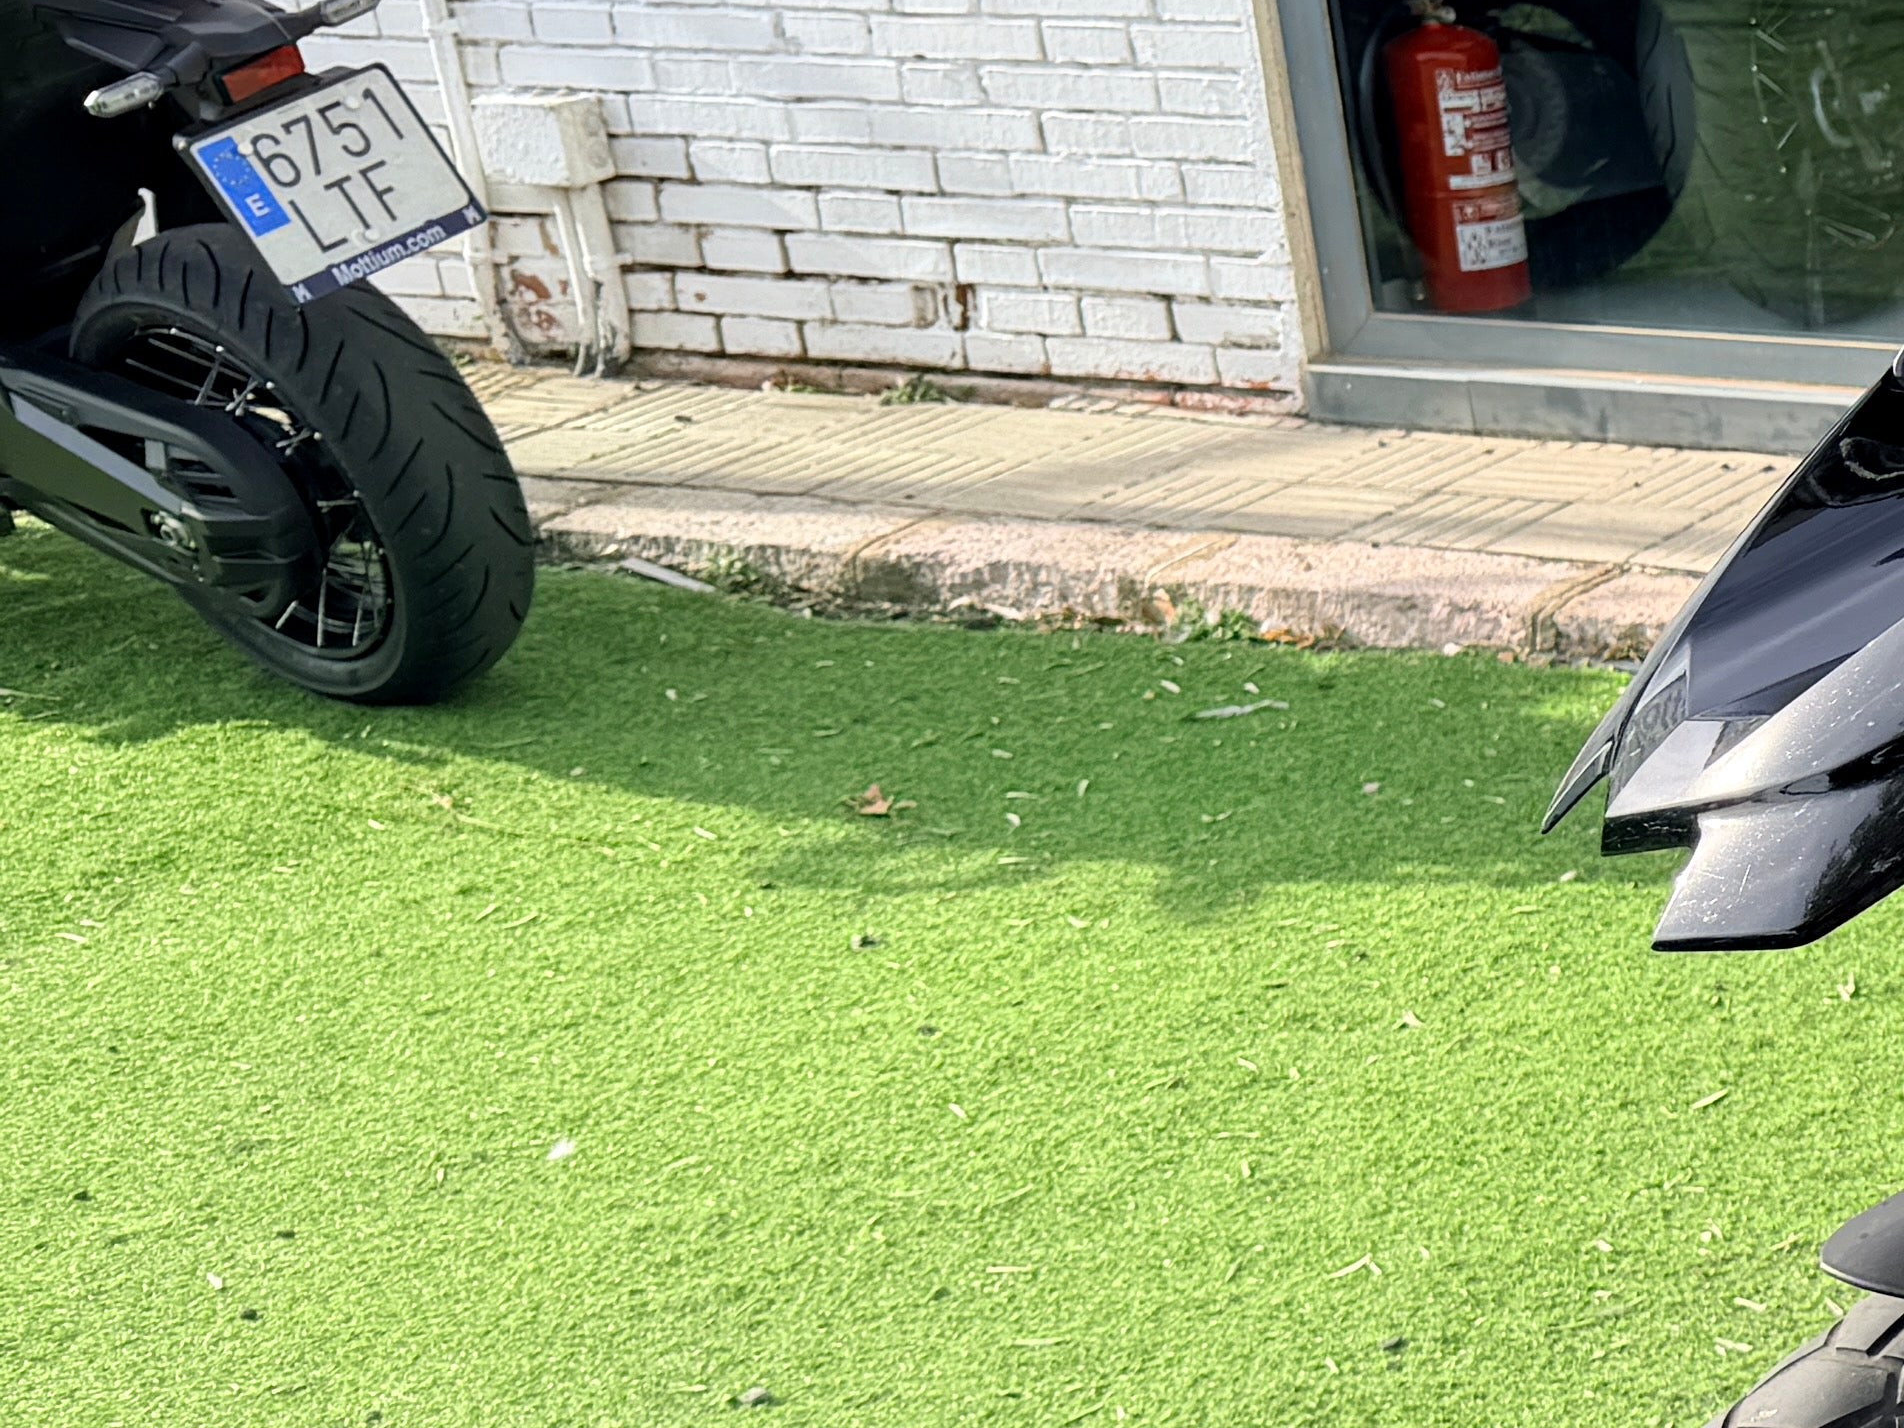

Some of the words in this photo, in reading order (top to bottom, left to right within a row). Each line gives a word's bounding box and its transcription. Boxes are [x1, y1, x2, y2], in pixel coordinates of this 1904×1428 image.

[250, 87, 404, 189] 6751
[245, 192, 270, 218] E
[288, 160, 398, 253] LTF
[331, 224, 447, 288] Mottium.com
